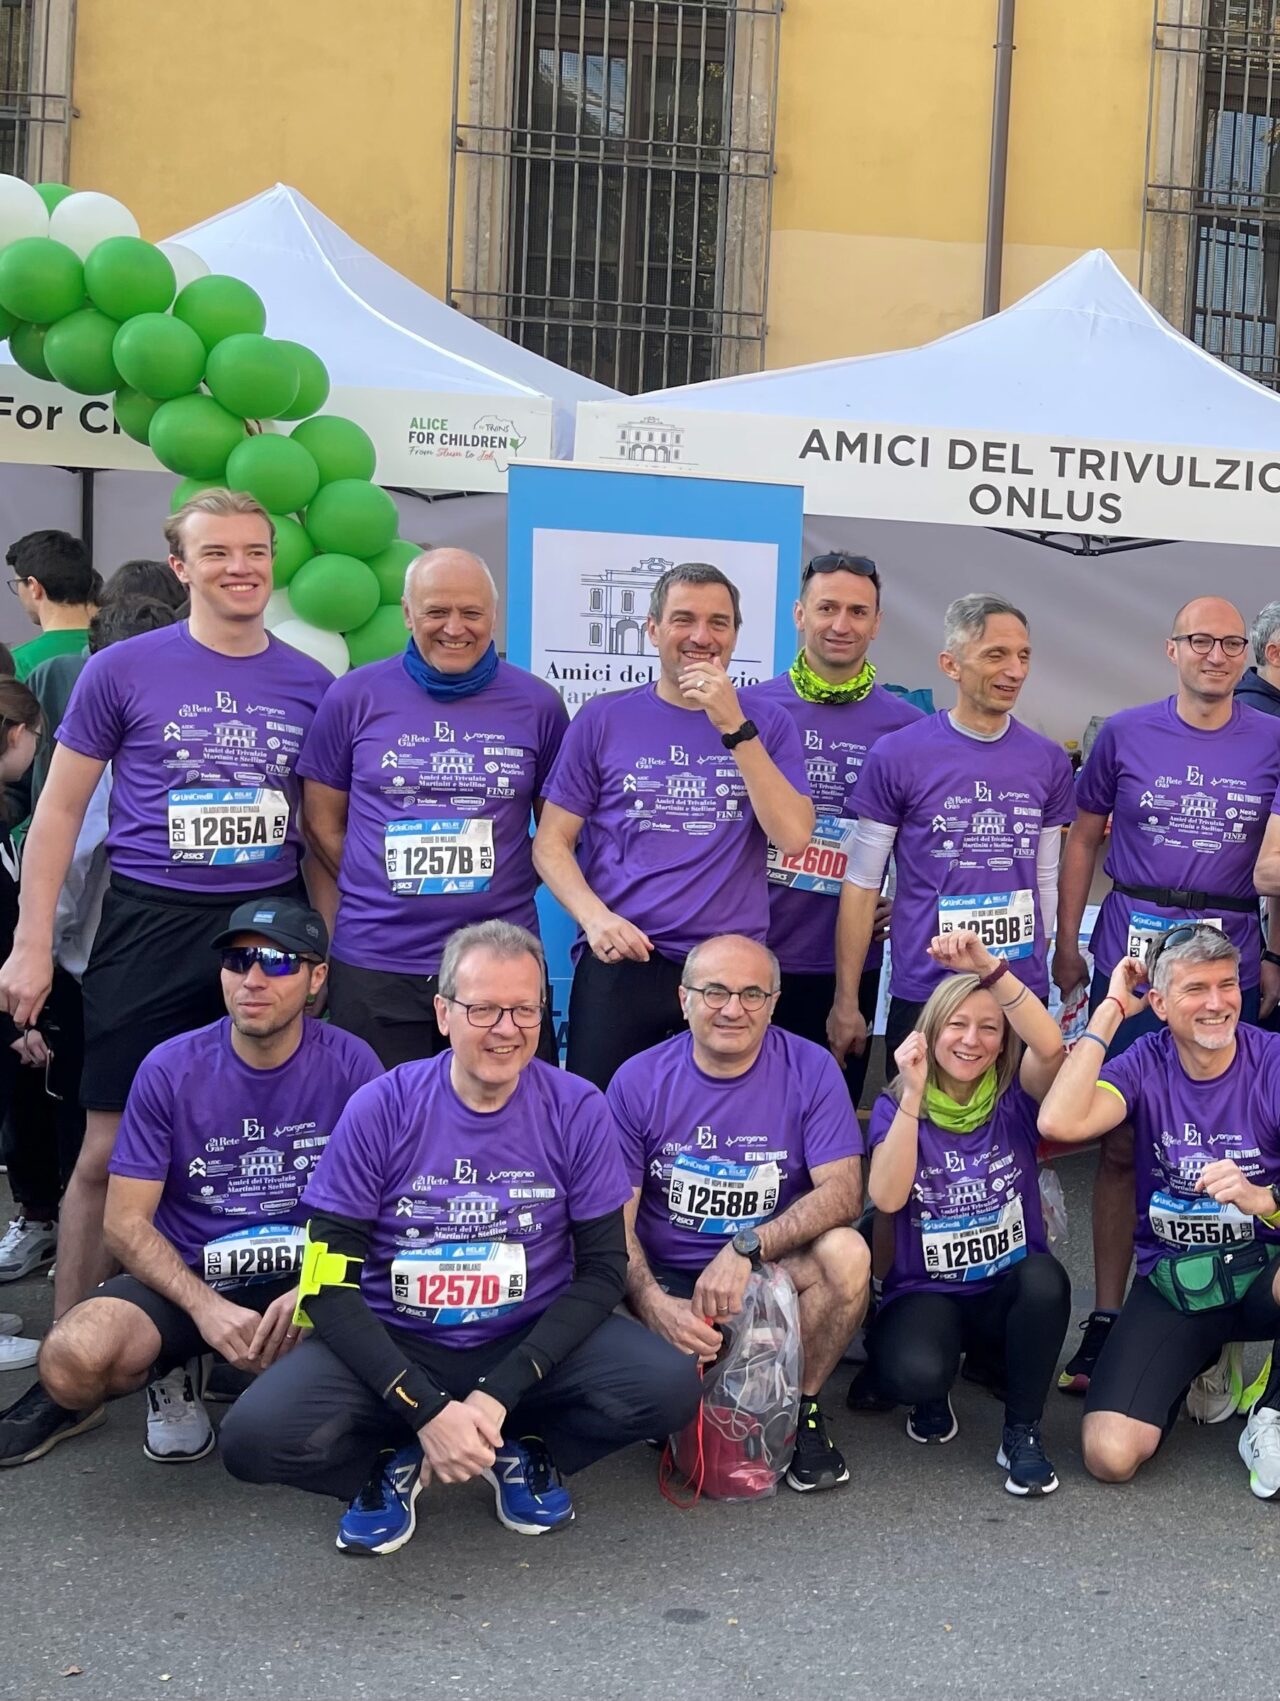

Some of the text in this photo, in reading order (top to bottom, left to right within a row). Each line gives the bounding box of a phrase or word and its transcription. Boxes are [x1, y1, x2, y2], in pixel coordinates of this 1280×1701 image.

[410, 418, 448, 430] ALICE
[408, 446, 433, 456] From
[465, 449, 475, 458] to
[409, 431, 507, 448] FOR CHILDREN
[799, 429, 929, 468] AMICI
[948, 439, 1033, 475] DEL
[969, 484, 1122, 524] ONLUS
[546, 661, 653, 683] Amici del
[487, 787, 515, 795] FINER
[191, 816, 267, 846] 1265A
[1223, 832, 1247, 841] FINER
[182, 852, 204, 860] asics
[403, 846, 473, 876] 1257B
[687, 1184, 759, 1217] 1258B
[1167, 1220, 1235, 1244] 1255A
[227, 1245, 305, 1276] 1286A
[942, 1229, 1010, 1268] 1260B
[417, 1274, 500, 1306] 1257D
